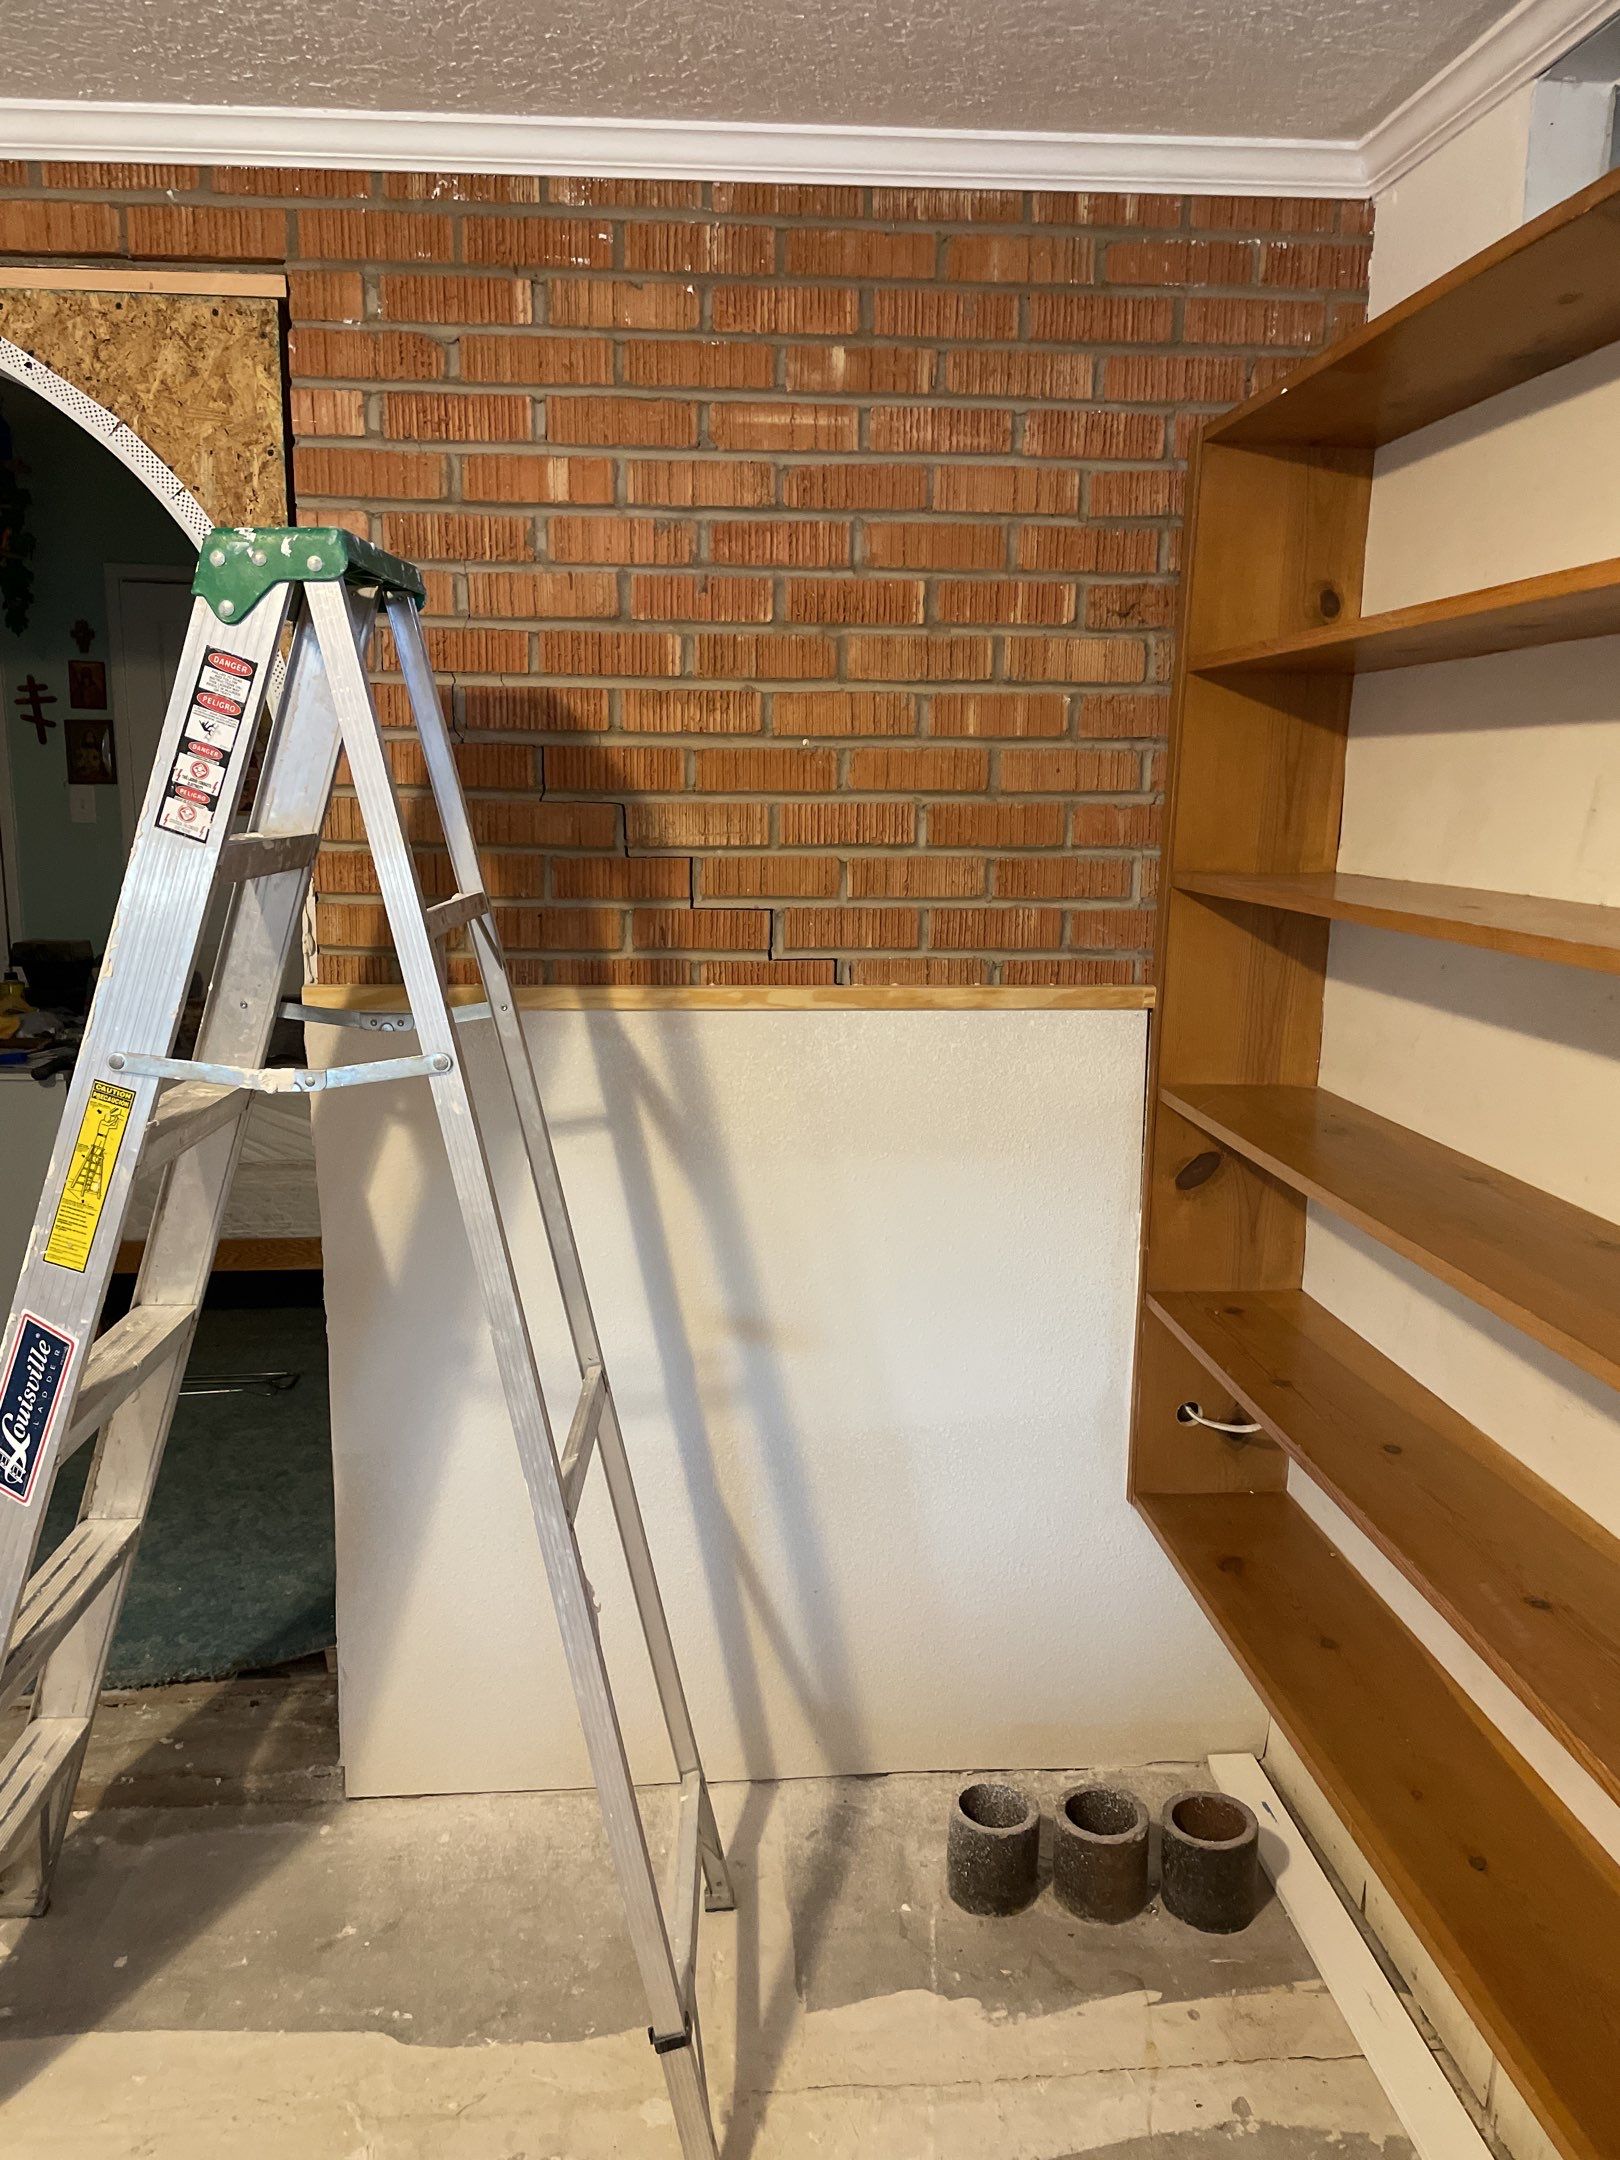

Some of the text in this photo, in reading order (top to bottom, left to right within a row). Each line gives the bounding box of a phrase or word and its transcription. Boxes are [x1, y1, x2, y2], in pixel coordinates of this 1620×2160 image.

[213, 656, 248, 673] DANGER
[202, 695, 236, 713] PELIGRO
[192, 744, 219, 757] DANGER
[179, 788, 206, 802] PELIGRO
[96, 1084, 132, 1100] CAUTION
[32, 1349, 61, 1430] LADDER
[2, 1339, 51, 1484] Louisville
